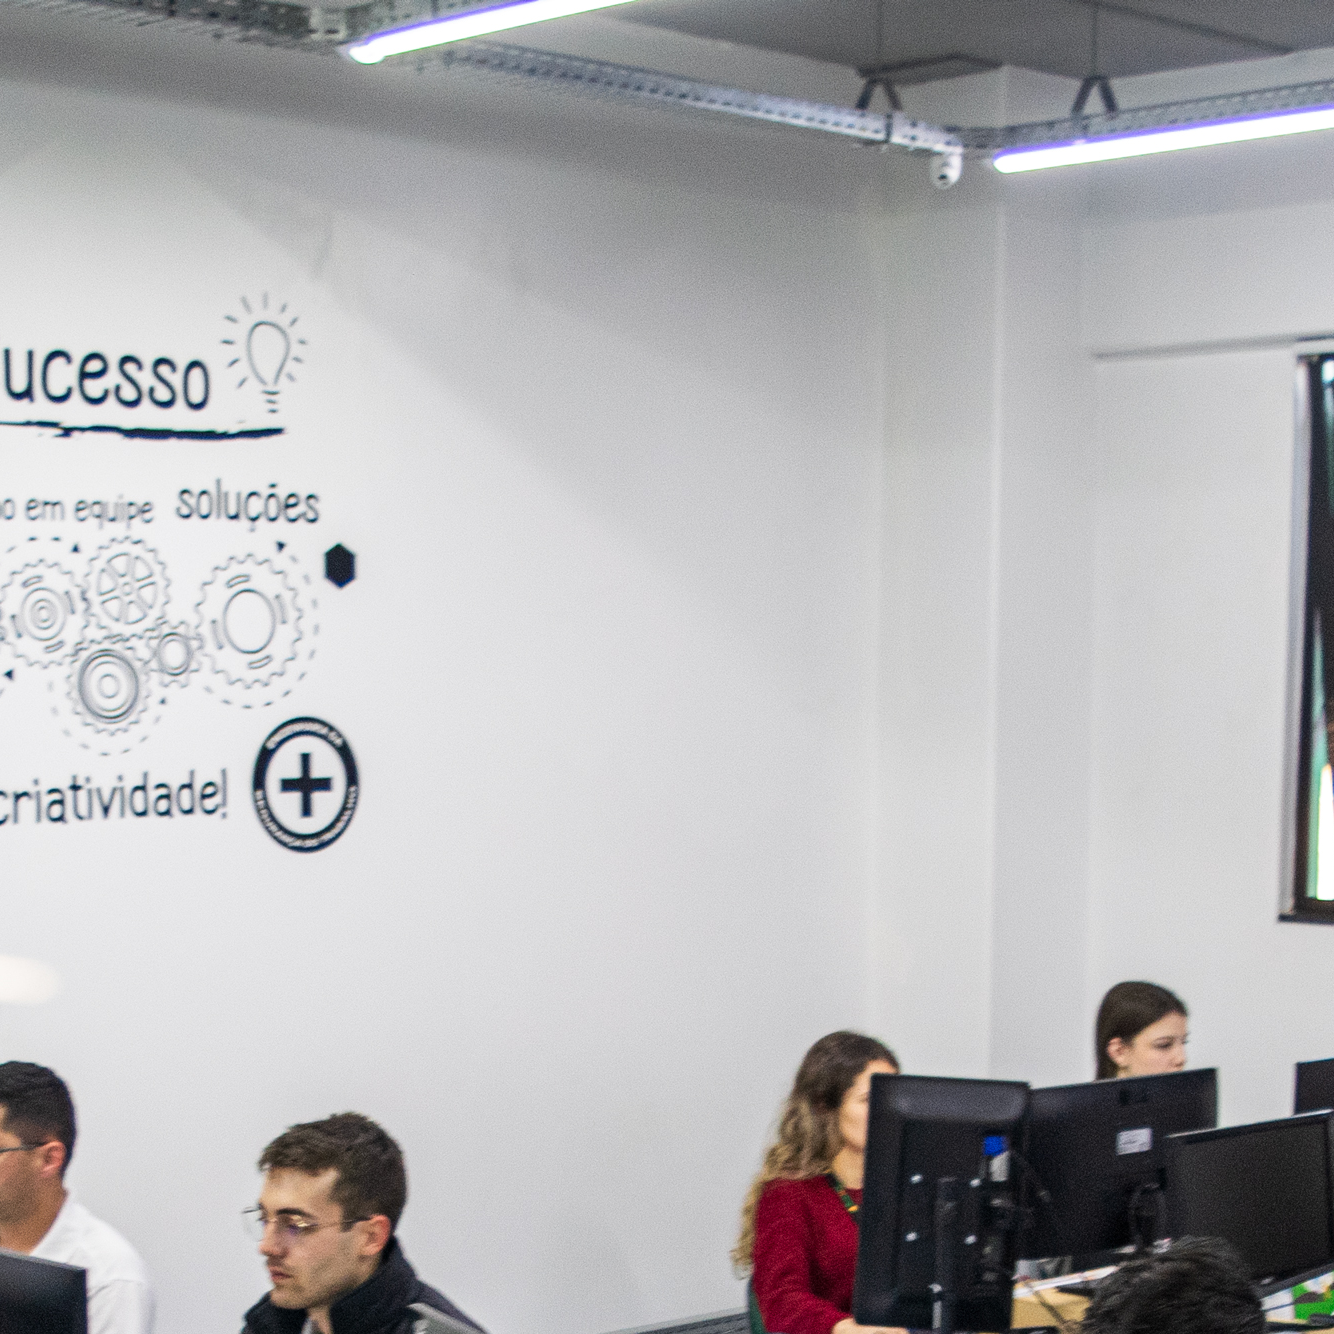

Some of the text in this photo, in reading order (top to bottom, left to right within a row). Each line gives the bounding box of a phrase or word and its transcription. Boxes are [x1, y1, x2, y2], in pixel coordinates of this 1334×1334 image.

[24, 498, 65, 522] em
[73, 498, 154, 528] equipe
[175, 478, 321, 527] soluções
